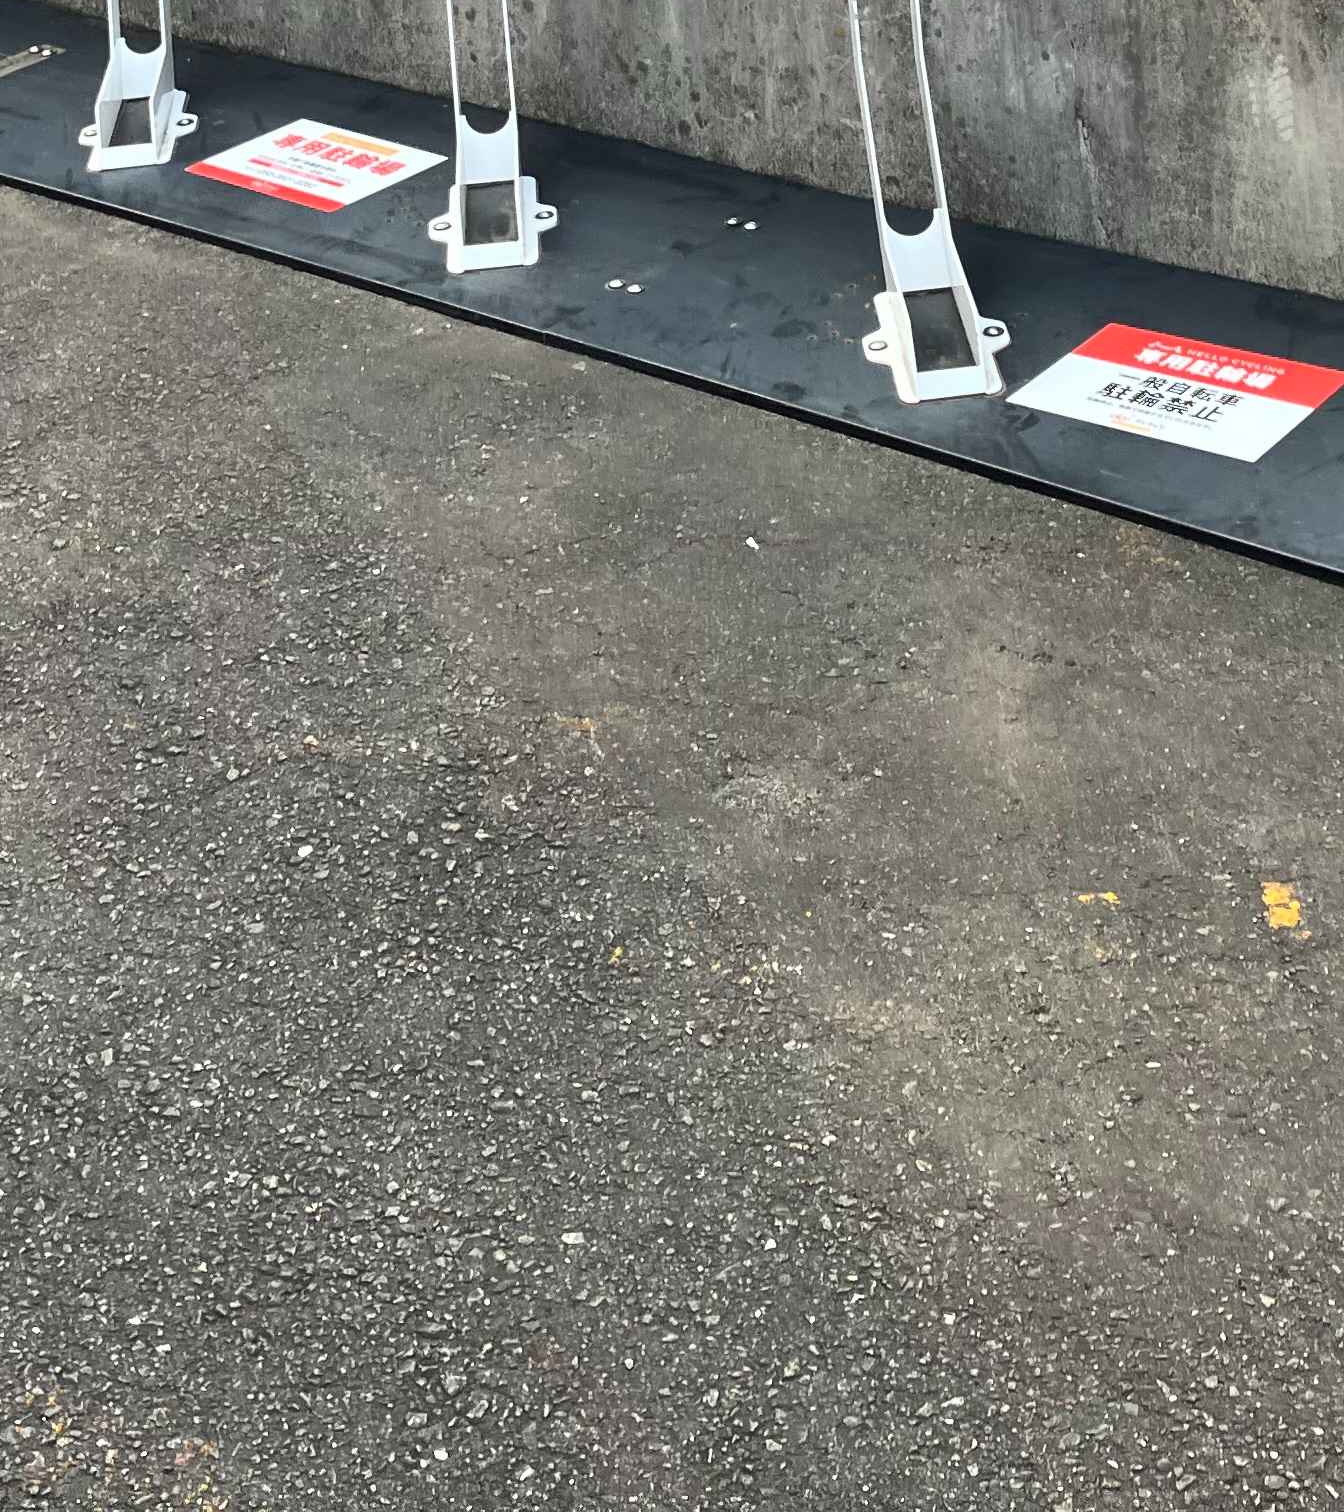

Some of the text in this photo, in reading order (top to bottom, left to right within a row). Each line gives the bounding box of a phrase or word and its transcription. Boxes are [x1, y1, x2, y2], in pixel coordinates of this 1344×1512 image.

[1101, 382, 1226, 424] 駐輪禁止
[1118, 373, 1244, 407] 一般自転車
